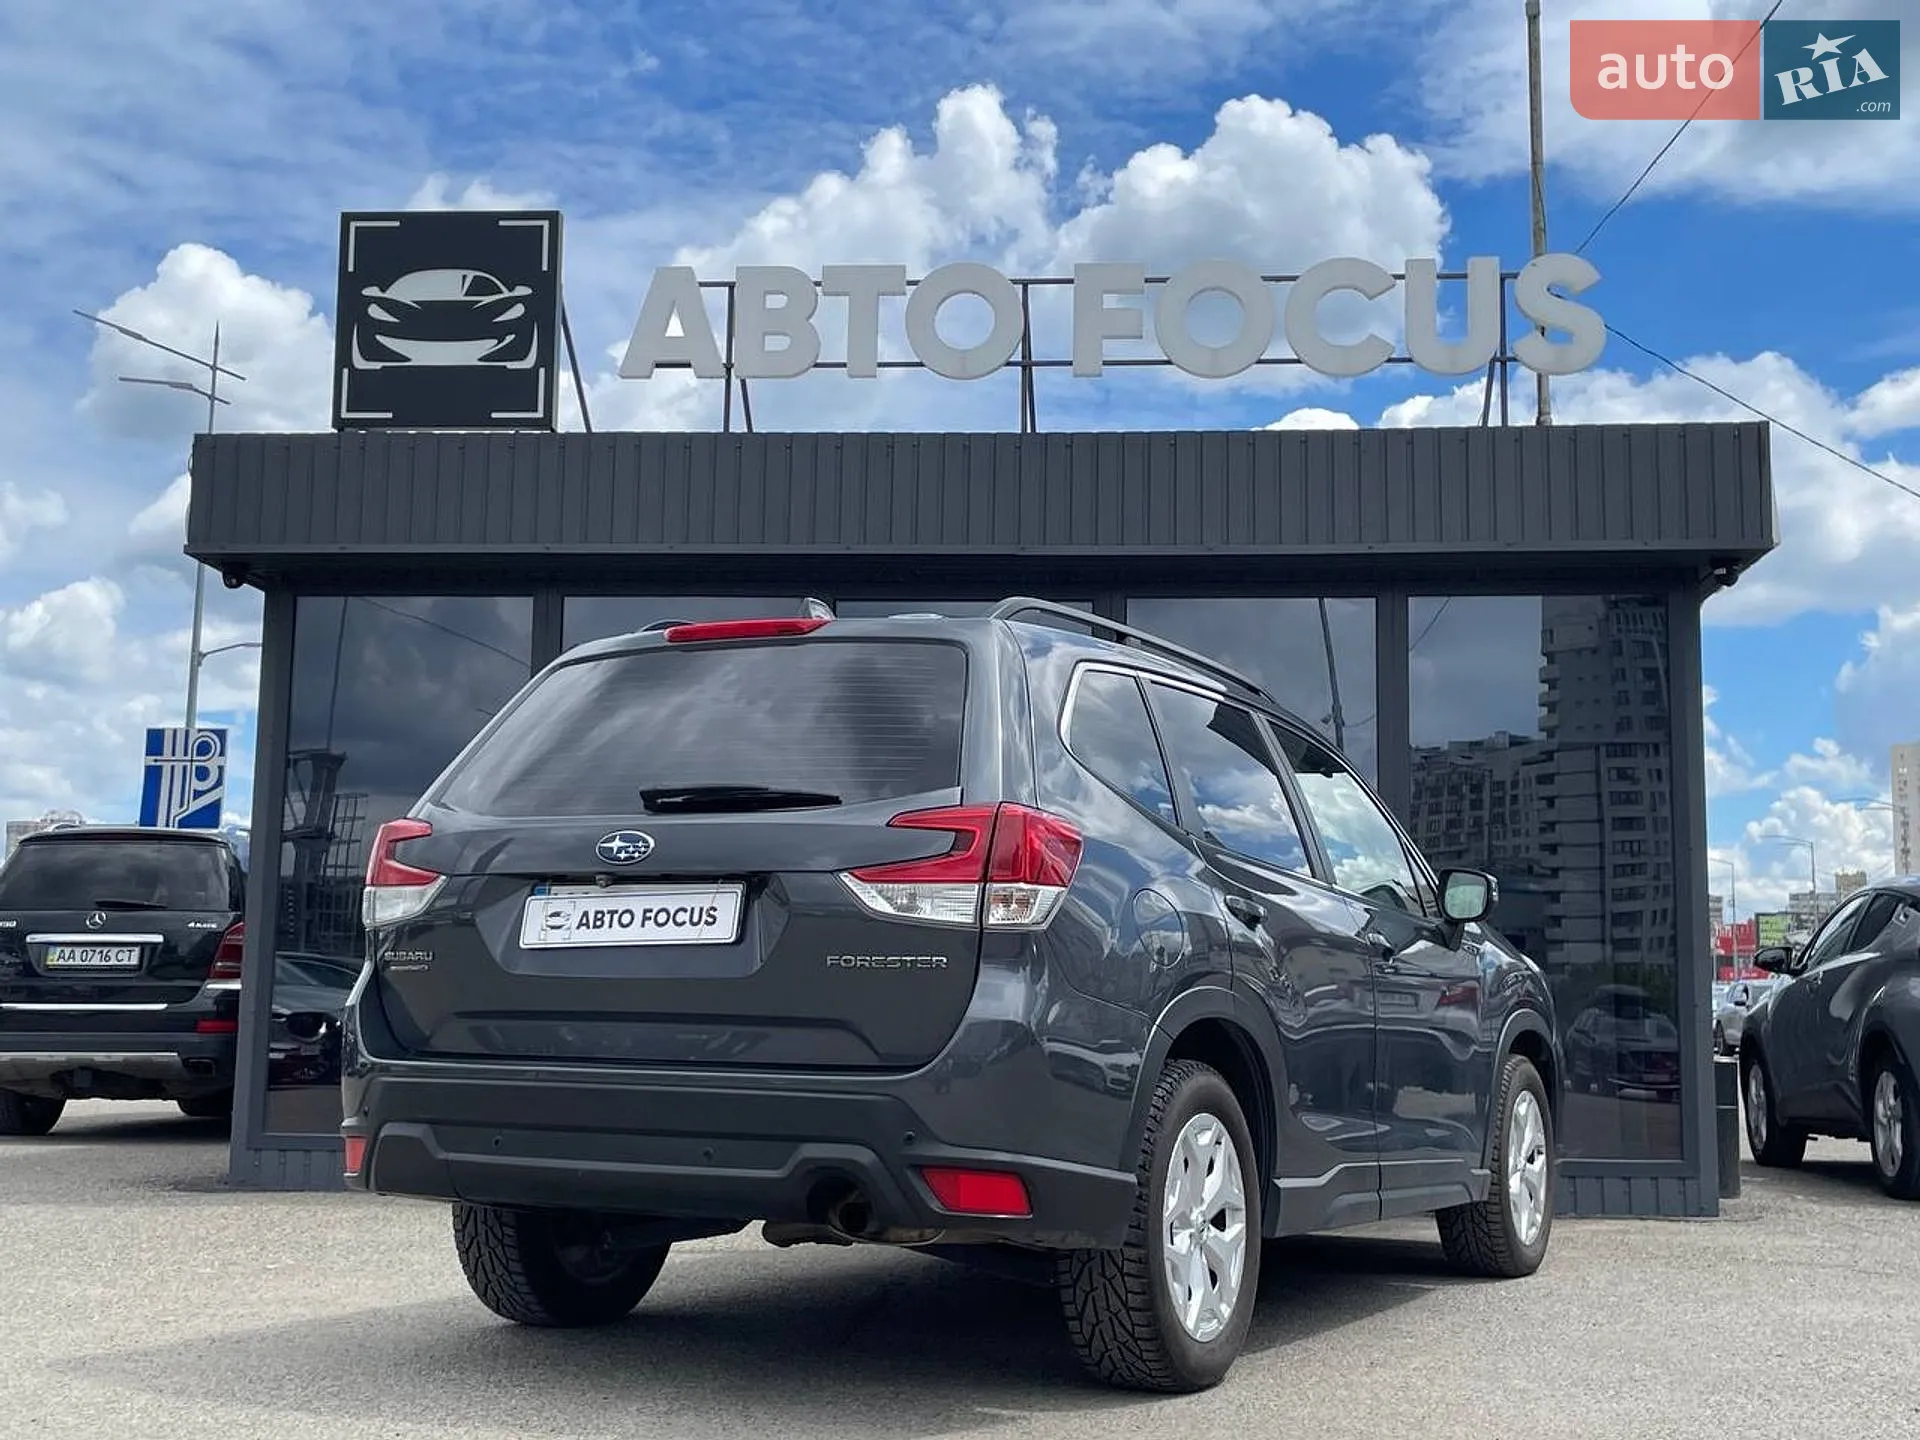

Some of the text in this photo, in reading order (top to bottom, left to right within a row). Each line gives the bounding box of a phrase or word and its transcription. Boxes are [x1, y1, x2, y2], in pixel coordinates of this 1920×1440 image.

[1072, 252, 1606, 379] FOCUS
[640, 905, 718, 928] FOCUS
[57, 949, 135, 963] AA 0716 CT
[384, 950, 433, 961] SUBARU
[826, 954, 948, 969] FORESTER
